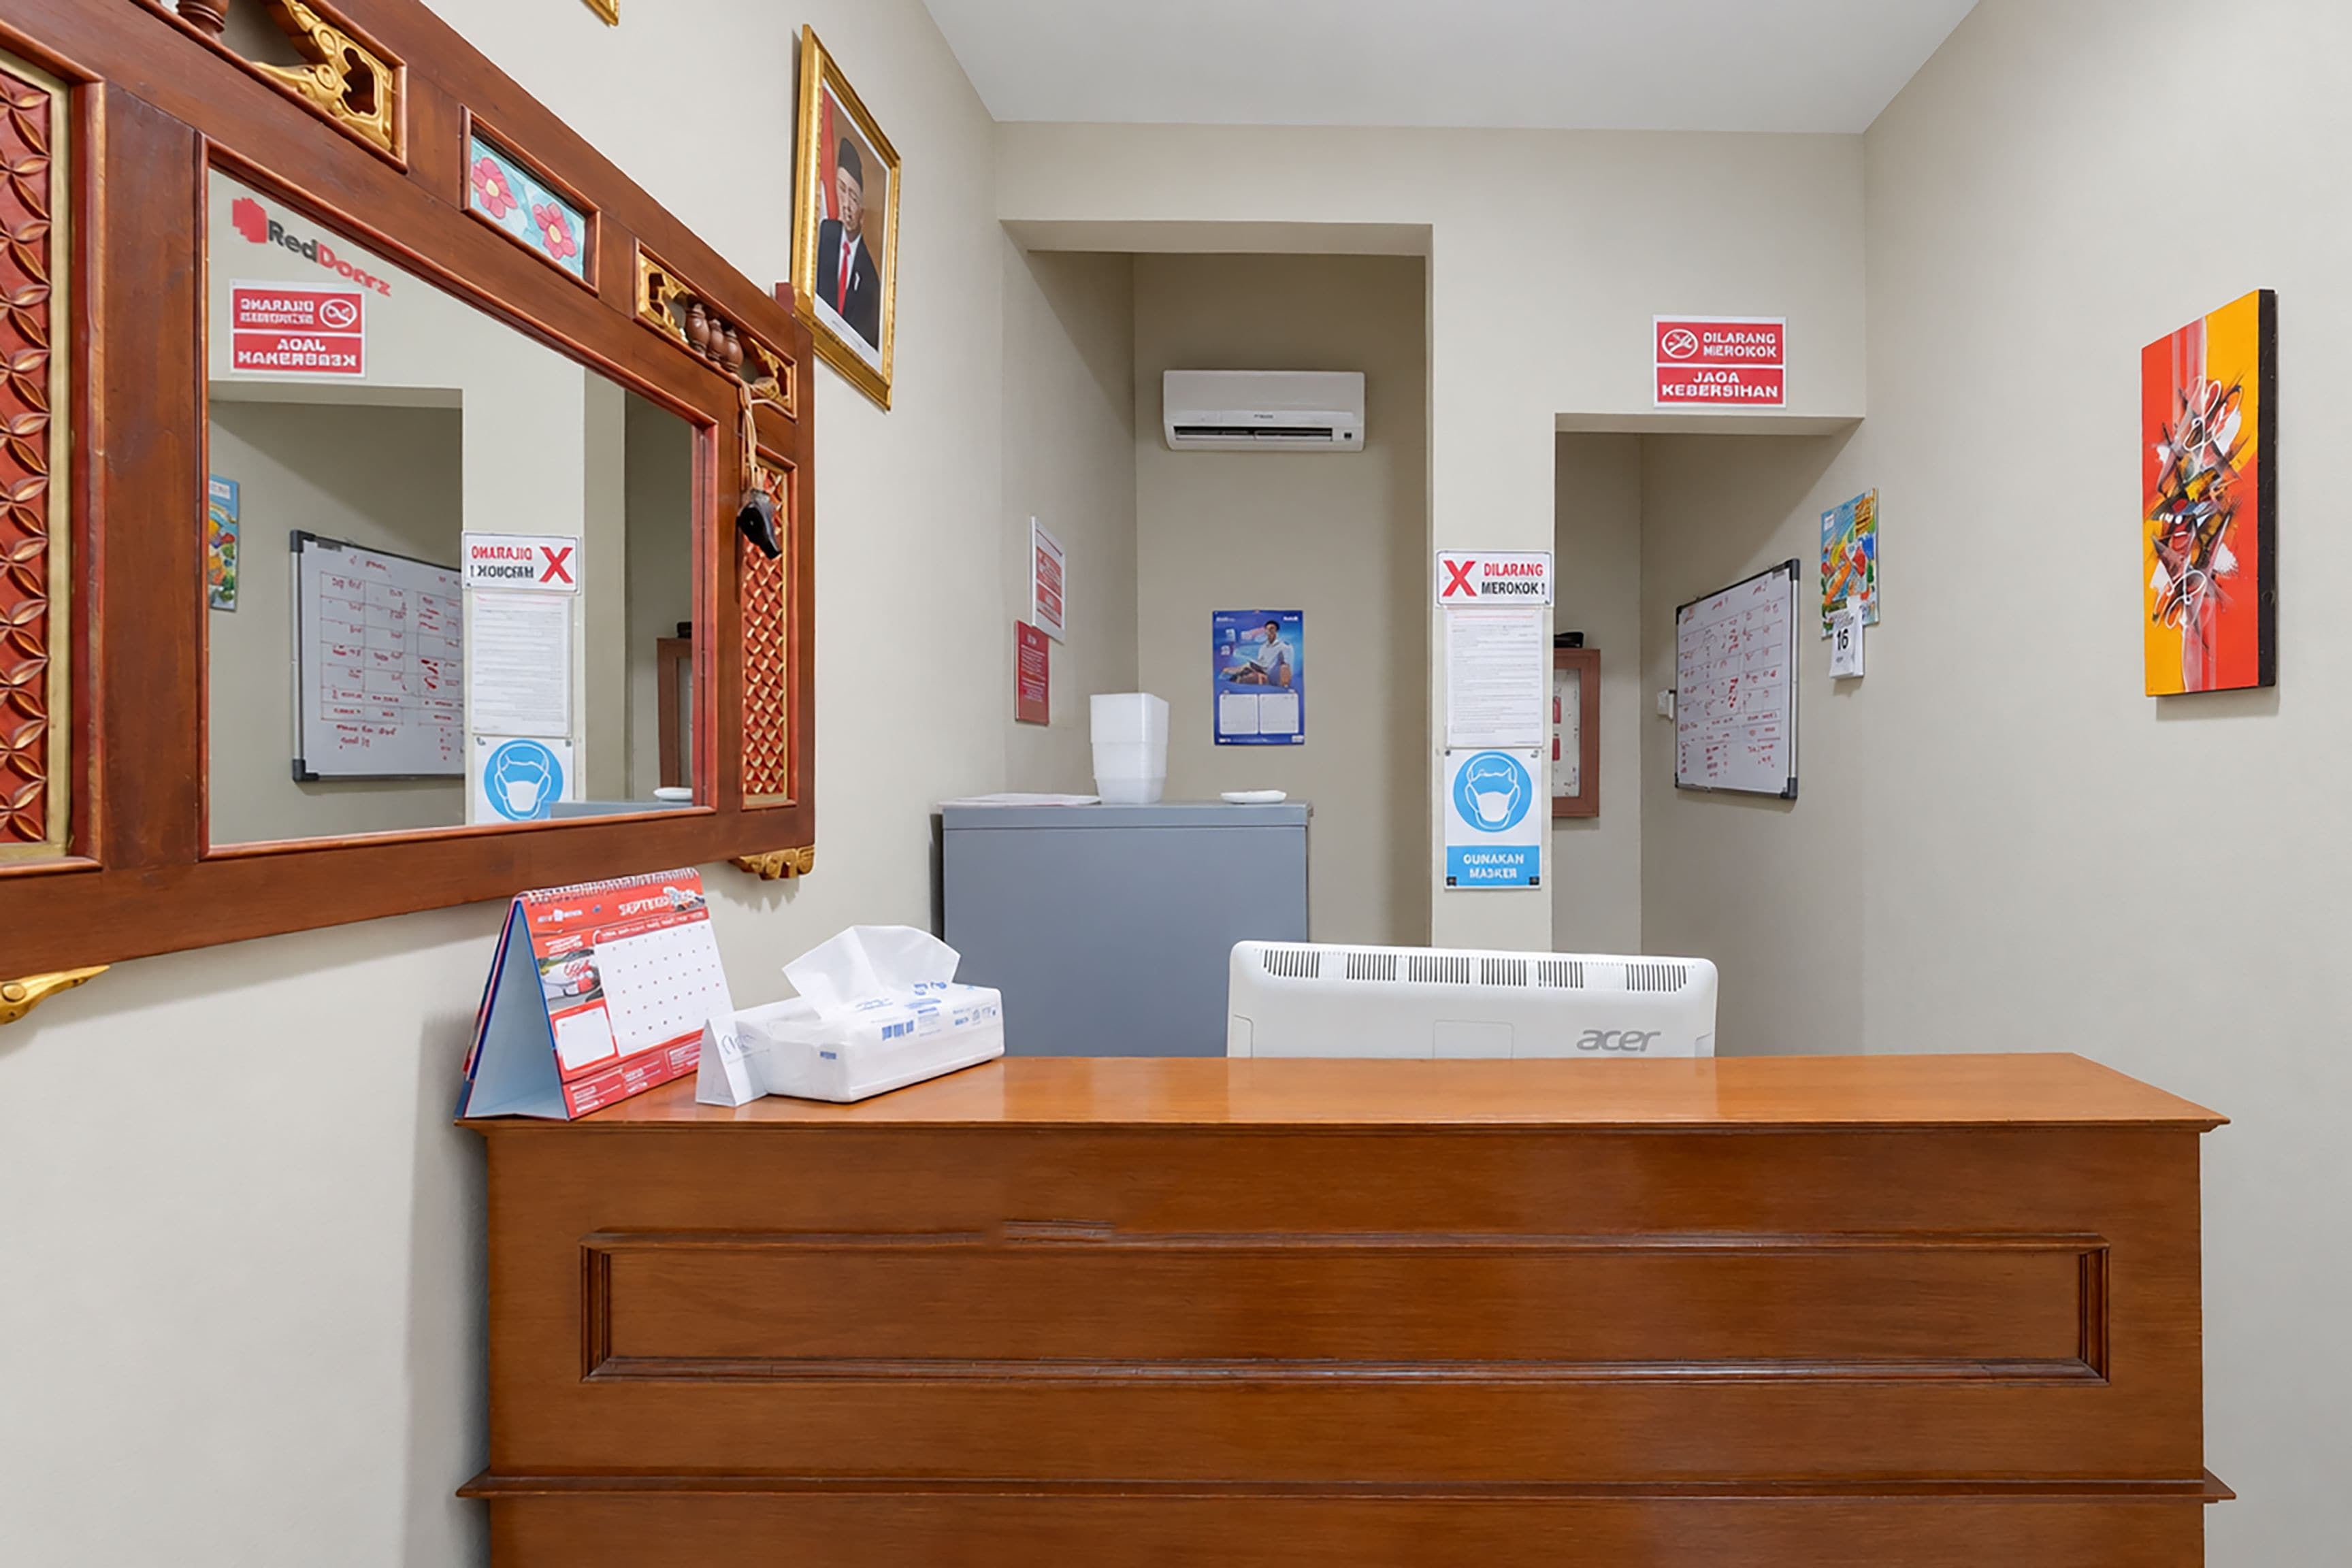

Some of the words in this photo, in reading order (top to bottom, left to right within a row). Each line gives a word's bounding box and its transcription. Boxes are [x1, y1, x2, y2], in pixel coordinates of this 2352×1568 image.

[1703, 331, 1776, 344] DILARANG
[1703, 345, 1777, 358] MEROKOK
[1661, 384, 1778, 398] KEBERSIHAN
[1484, 562, 1544, 577] DILARANG
[1481, 581, 1539, 595] MEROKOK
[1836, 628, 1849, 651] 16
[1576, 1029, 1662, 1053] acer
